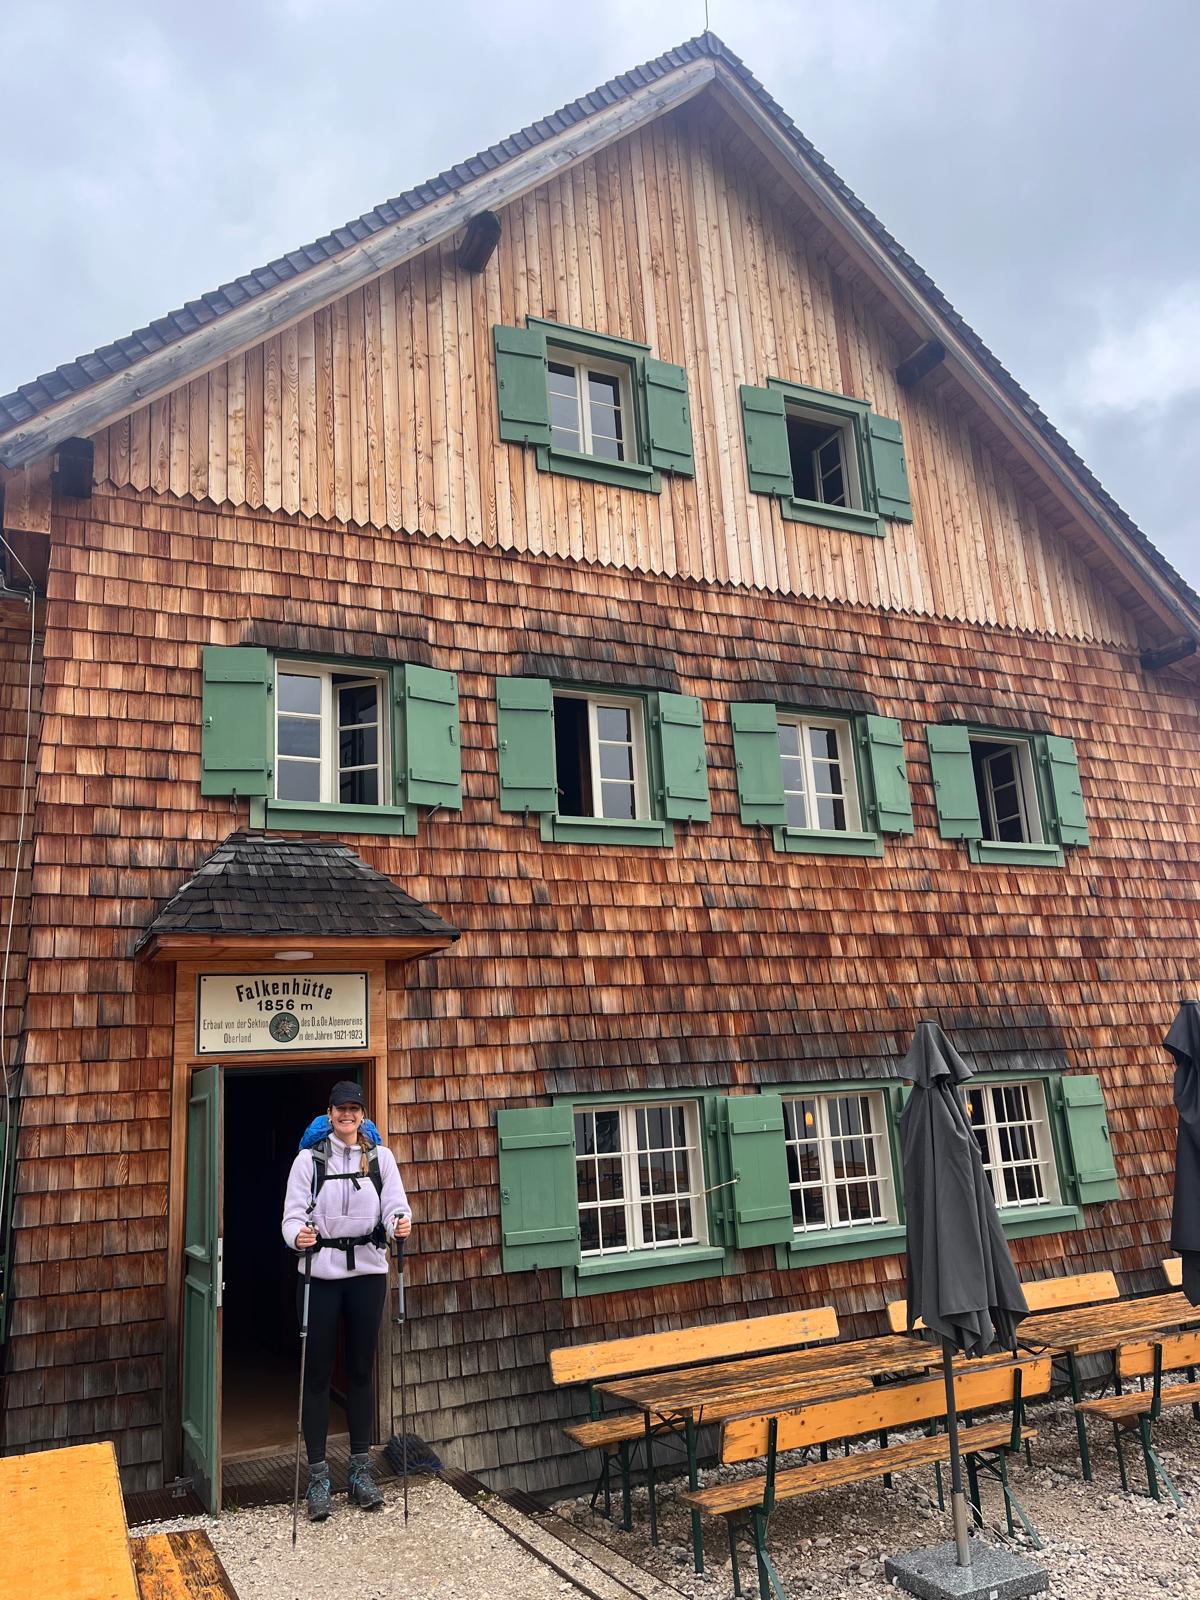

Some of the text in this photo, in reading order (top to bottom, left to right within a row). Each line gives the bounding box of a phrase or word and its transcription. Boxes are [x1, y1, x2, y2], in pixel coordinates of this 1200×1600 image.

[235, 978, 333, 1003] Falkenhütte
[257, 999, 313, 1011] 1856 m
[203, 1018, 269, 1030] Erbaut von der Sektion
[301, 1018, 311, 1027] des
[328, 1016, 363, 1027] Alpenvereins
[223, 1032, 252, 1043] Oberland
[304, 1031, 314, 1040] den
[314, 1029, 333, 1040] Jahren
[333, 1029, 363, 1040] 1921-1923
